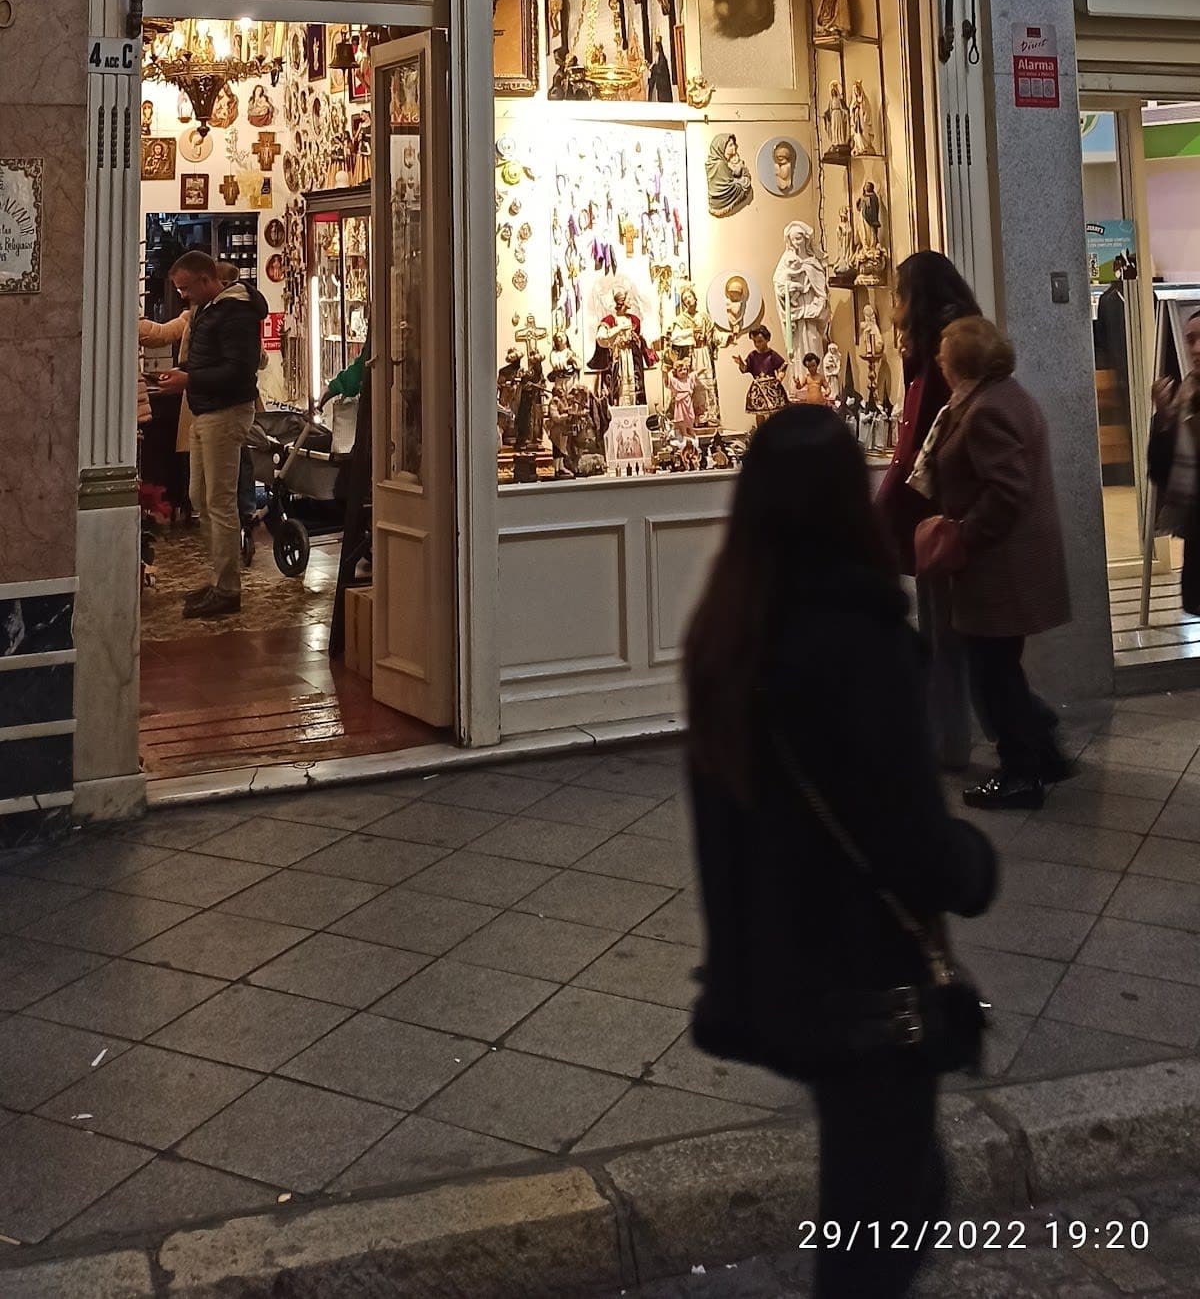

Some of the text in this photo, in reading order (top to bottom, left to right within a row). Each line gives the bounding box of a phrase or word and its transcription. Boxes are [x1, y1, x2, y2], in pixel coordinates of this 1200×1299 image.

[90, 42, 101, 67] 4
[122, 44, 133, 68] C
[1018, 58, 1054, 71] Alarma
